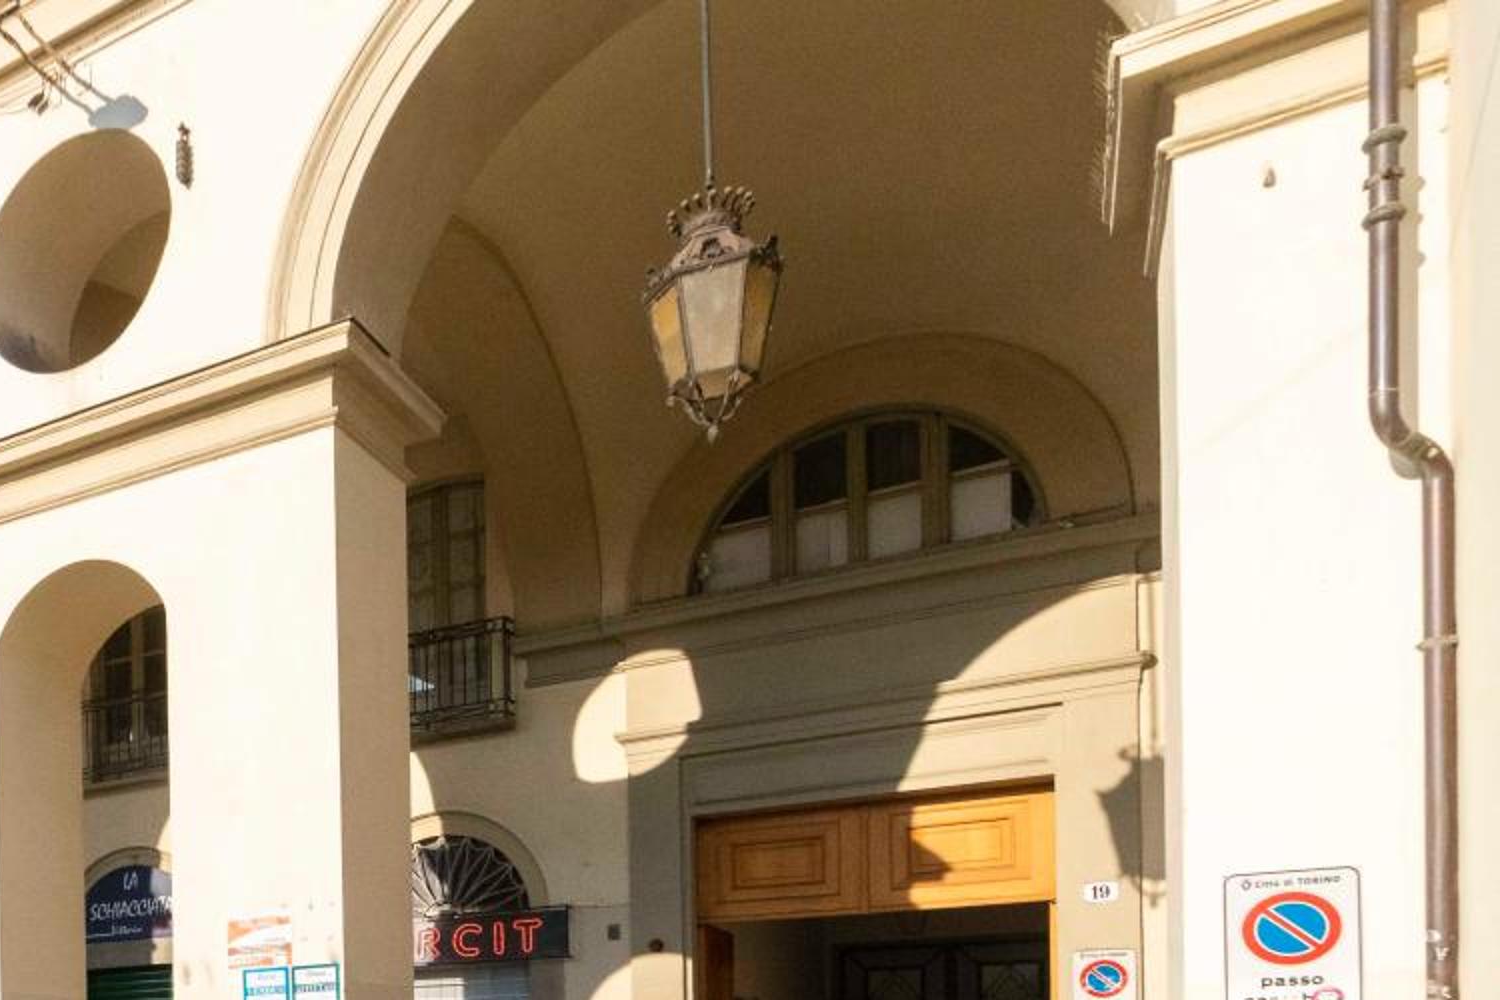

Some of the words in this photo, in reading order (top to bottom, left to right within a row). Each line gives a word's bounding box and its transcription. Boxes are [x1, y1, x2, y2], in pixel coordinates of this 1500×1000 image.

[123, 871, 139, 891] LA
[1092, 884, 1111, 899] 19
[1261, 975, 1325, 989] passo
